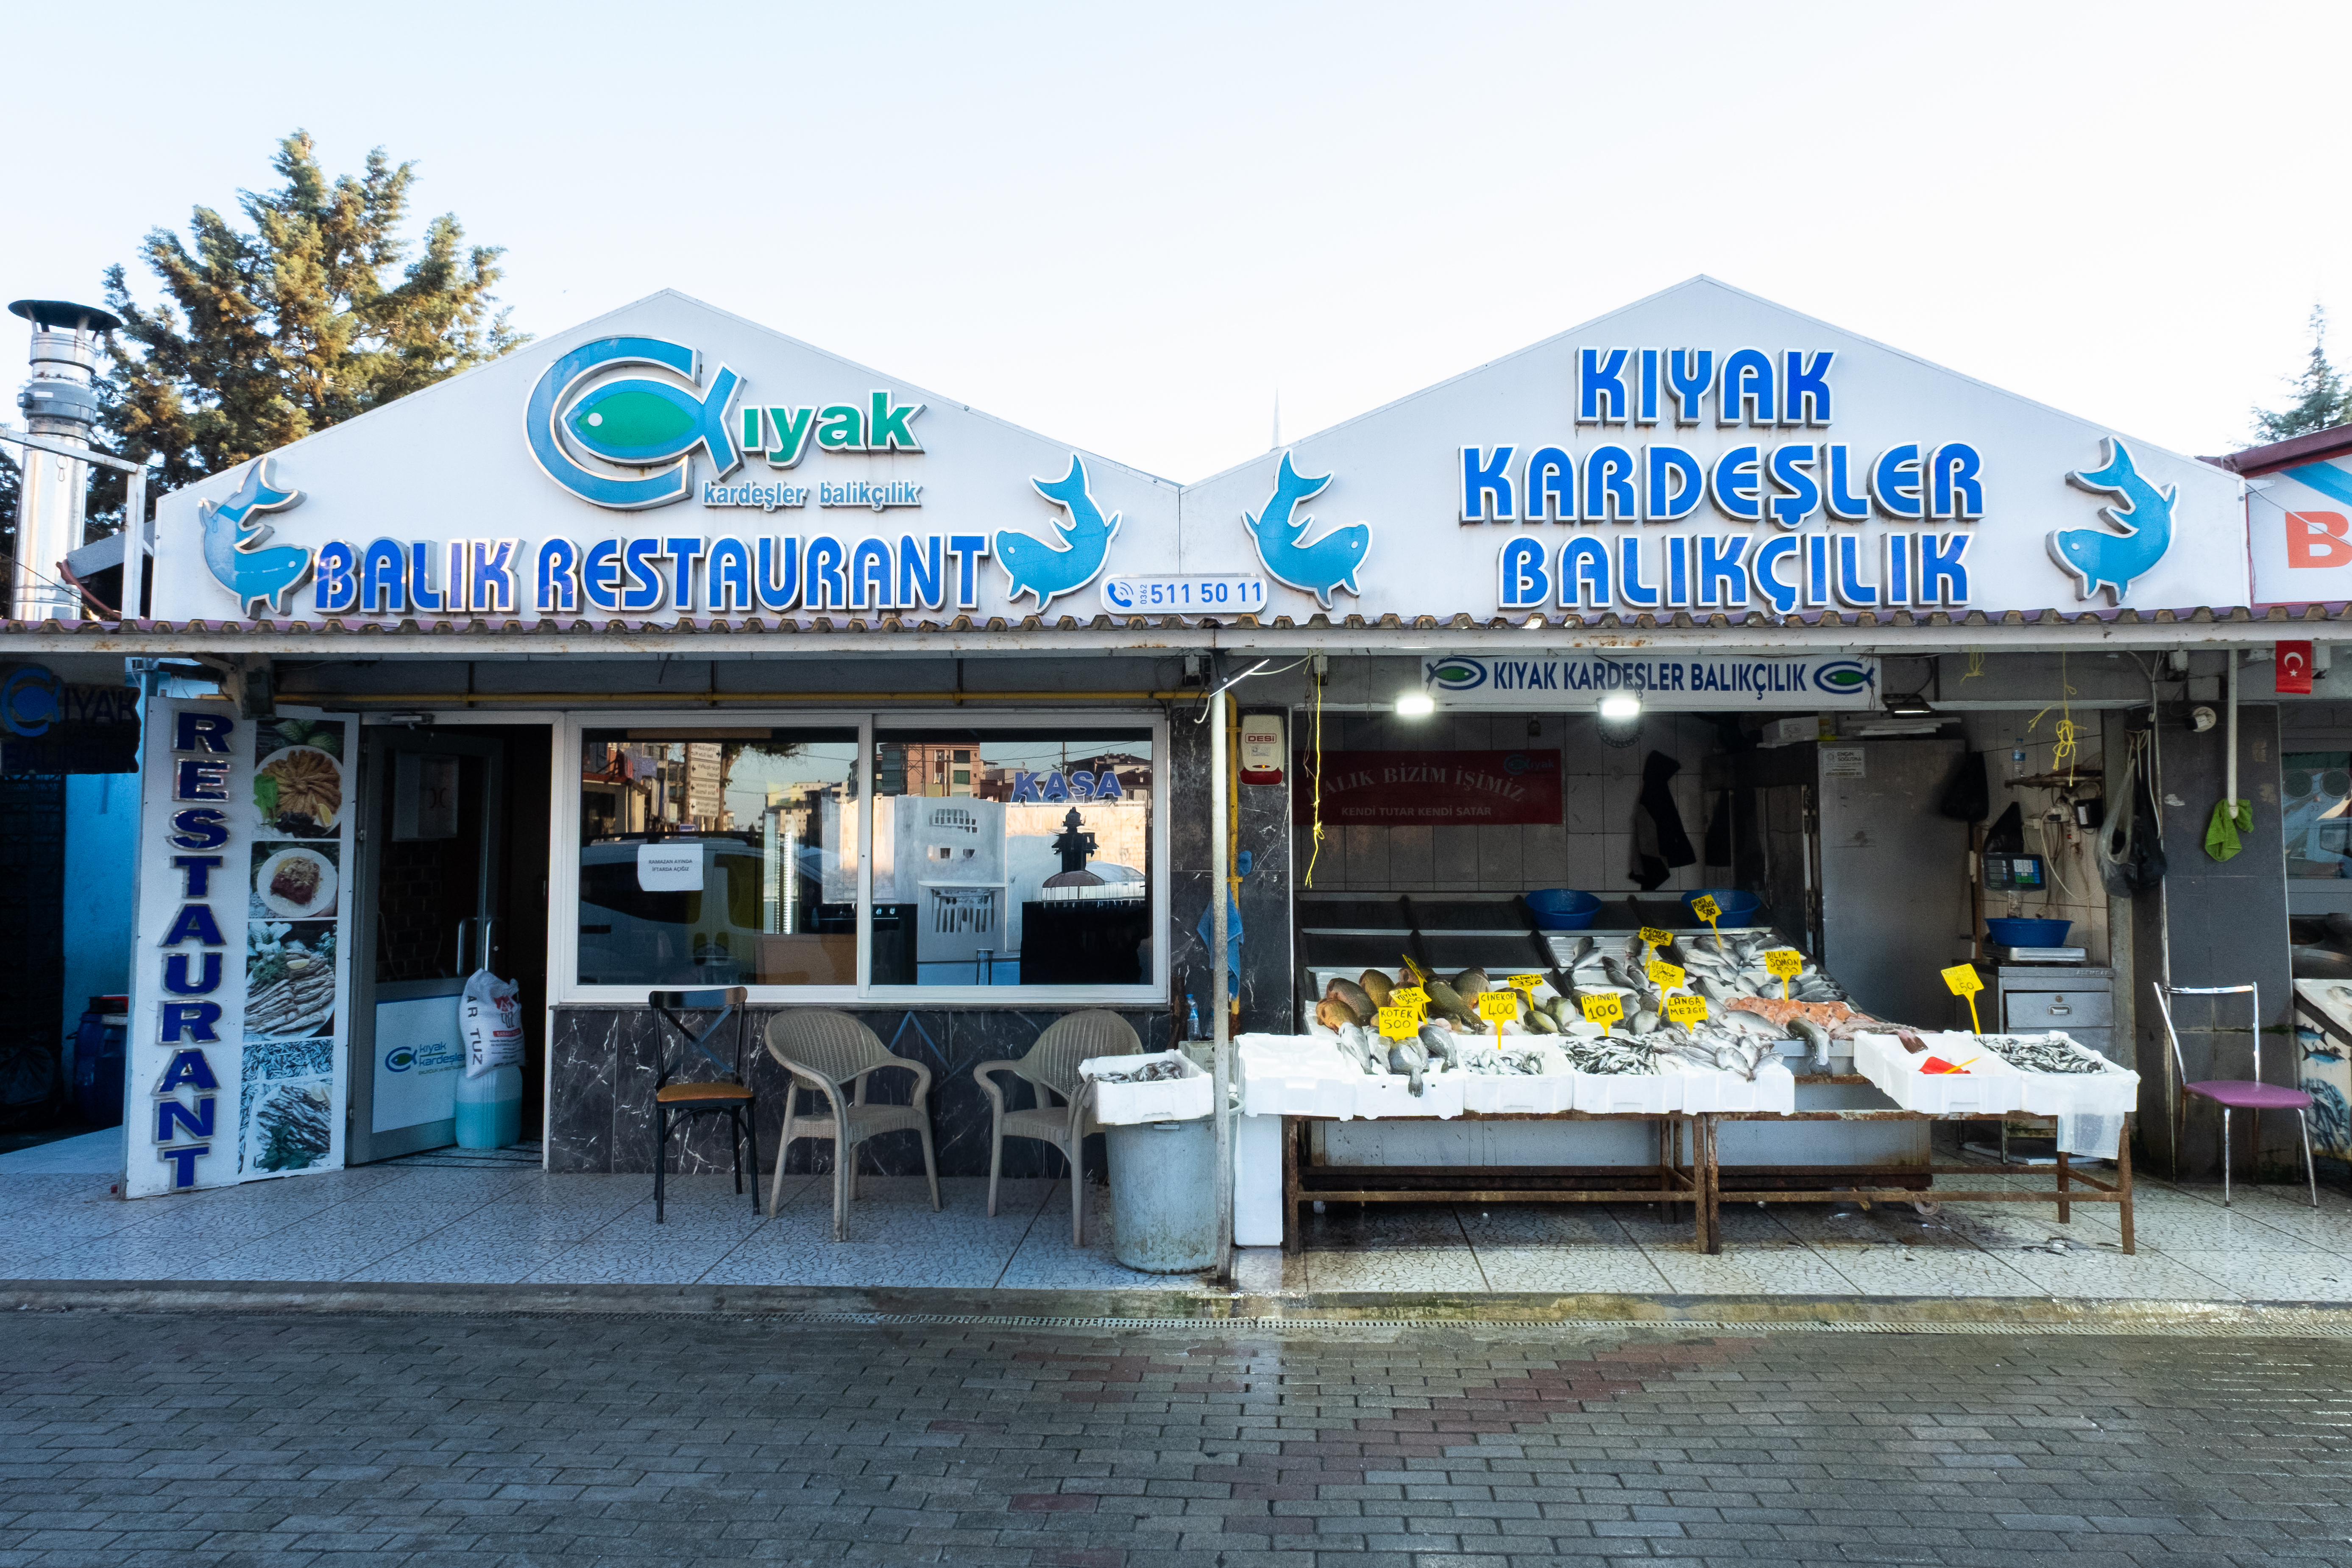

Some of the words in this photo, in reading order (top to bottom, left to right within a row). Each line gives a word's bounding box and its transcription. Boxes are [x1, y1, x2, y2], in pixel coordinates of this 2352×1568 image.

[1576, 346, 1838, 425] KIYAK
[702, 480, 805, 511] kardeşler
[1460, 441, 1986, 529] KARDEŞLER
[313, 537, 522, 613] BALIK
[533, 531, 990, 613] RESTAURANT
[1498, 532, 1974, 615] BALIKÇILIK
[1151, 584, 1189, 604] 511
[1201, 583, 1228, 603] 50
[1237, 582, 1261, 602] 11
[1494, 662, 1558, 690] KIYAK
[1563, 662, 1684, 699] KARDEŞLER
[1689, 663, 1805, 700] BALIKÇILIK
[1010, 771, 1124, 802] KASA
[1384, 762, 1448, 784] BİZİM
[1455, 765, 1527, 802] İŞİMİZ
[1341, 805, 1377, 816] KENDİ
[1380, 807, 1415, 816] TUTAR
[1418, 805, 1452, 816] KENDİ
[1456, 807, 1492, 816] SATAR
[1703, 908, 1716, 918] 500
[150, 710, 235, 1190] RESTAURANT
[1770, 958, 1799, 967] SOMON
[1955, 982, 1974, 993] 150
[1381, 1008, 1413, 1019] KÖTEK
[1488, 1003, 1514, 1016] 400
[1588, 1004, 1618, 1020] 100
[1384, 1019, 1411, 1029] 500
[419, 1041, 446, 1054] kıyak
